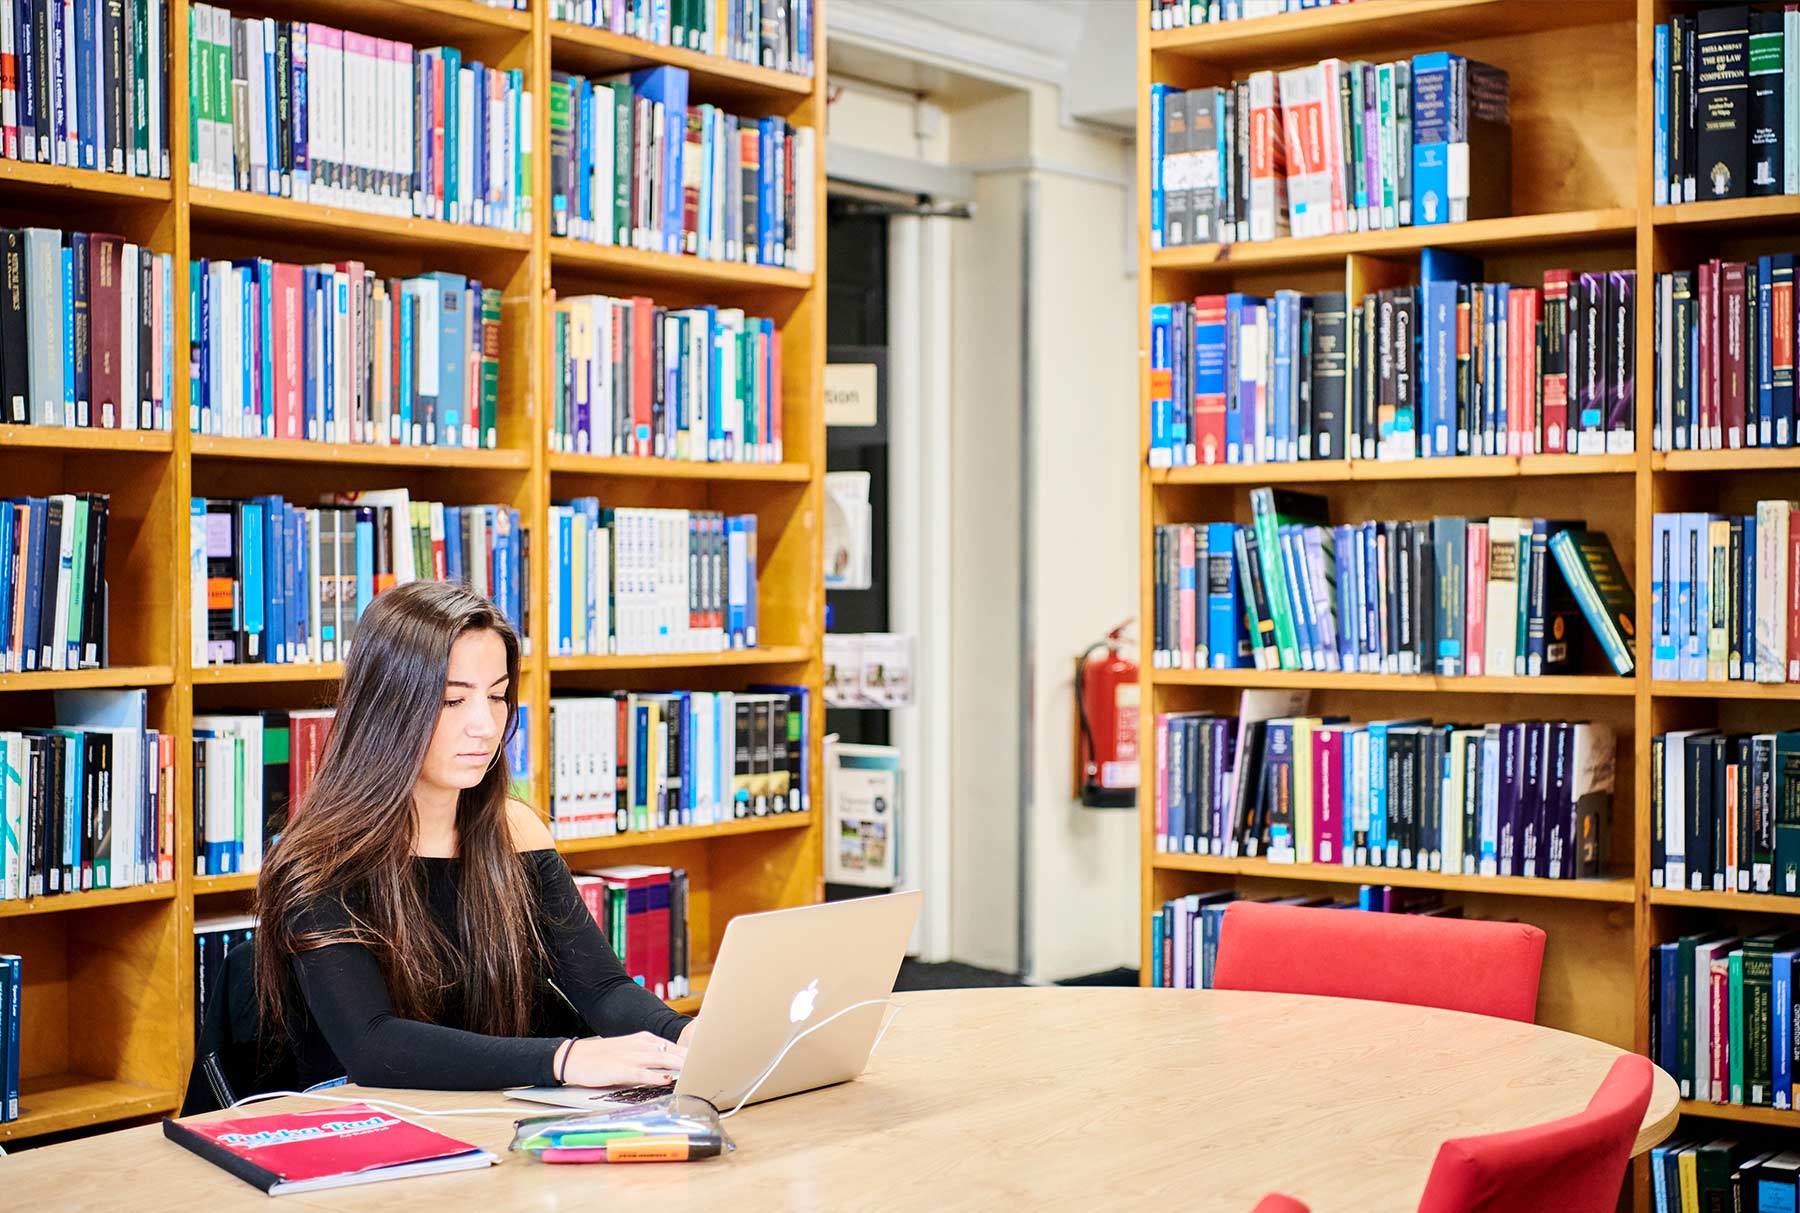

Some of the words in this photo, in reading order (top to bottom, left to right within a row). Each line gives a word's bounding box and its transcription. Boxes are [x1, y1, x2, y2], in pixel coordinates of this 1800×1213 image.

[1703, 56, 1716, 65] THE
[1726, 54, 1741, 63] LAW
[1699, 70, 1745, 82] COMPETITION
[1382, 302, 1393, 354] Company
[1395, 311, 1409, 372] Company
[1382, 355, 1393, 380] Law
[1397, 374, 1409, 401] Law
[1370, 790, 1379, 815] LAW
[217, 1127, 324, 1144] Pukka
[321, 1116, 385, 1132] Pad
